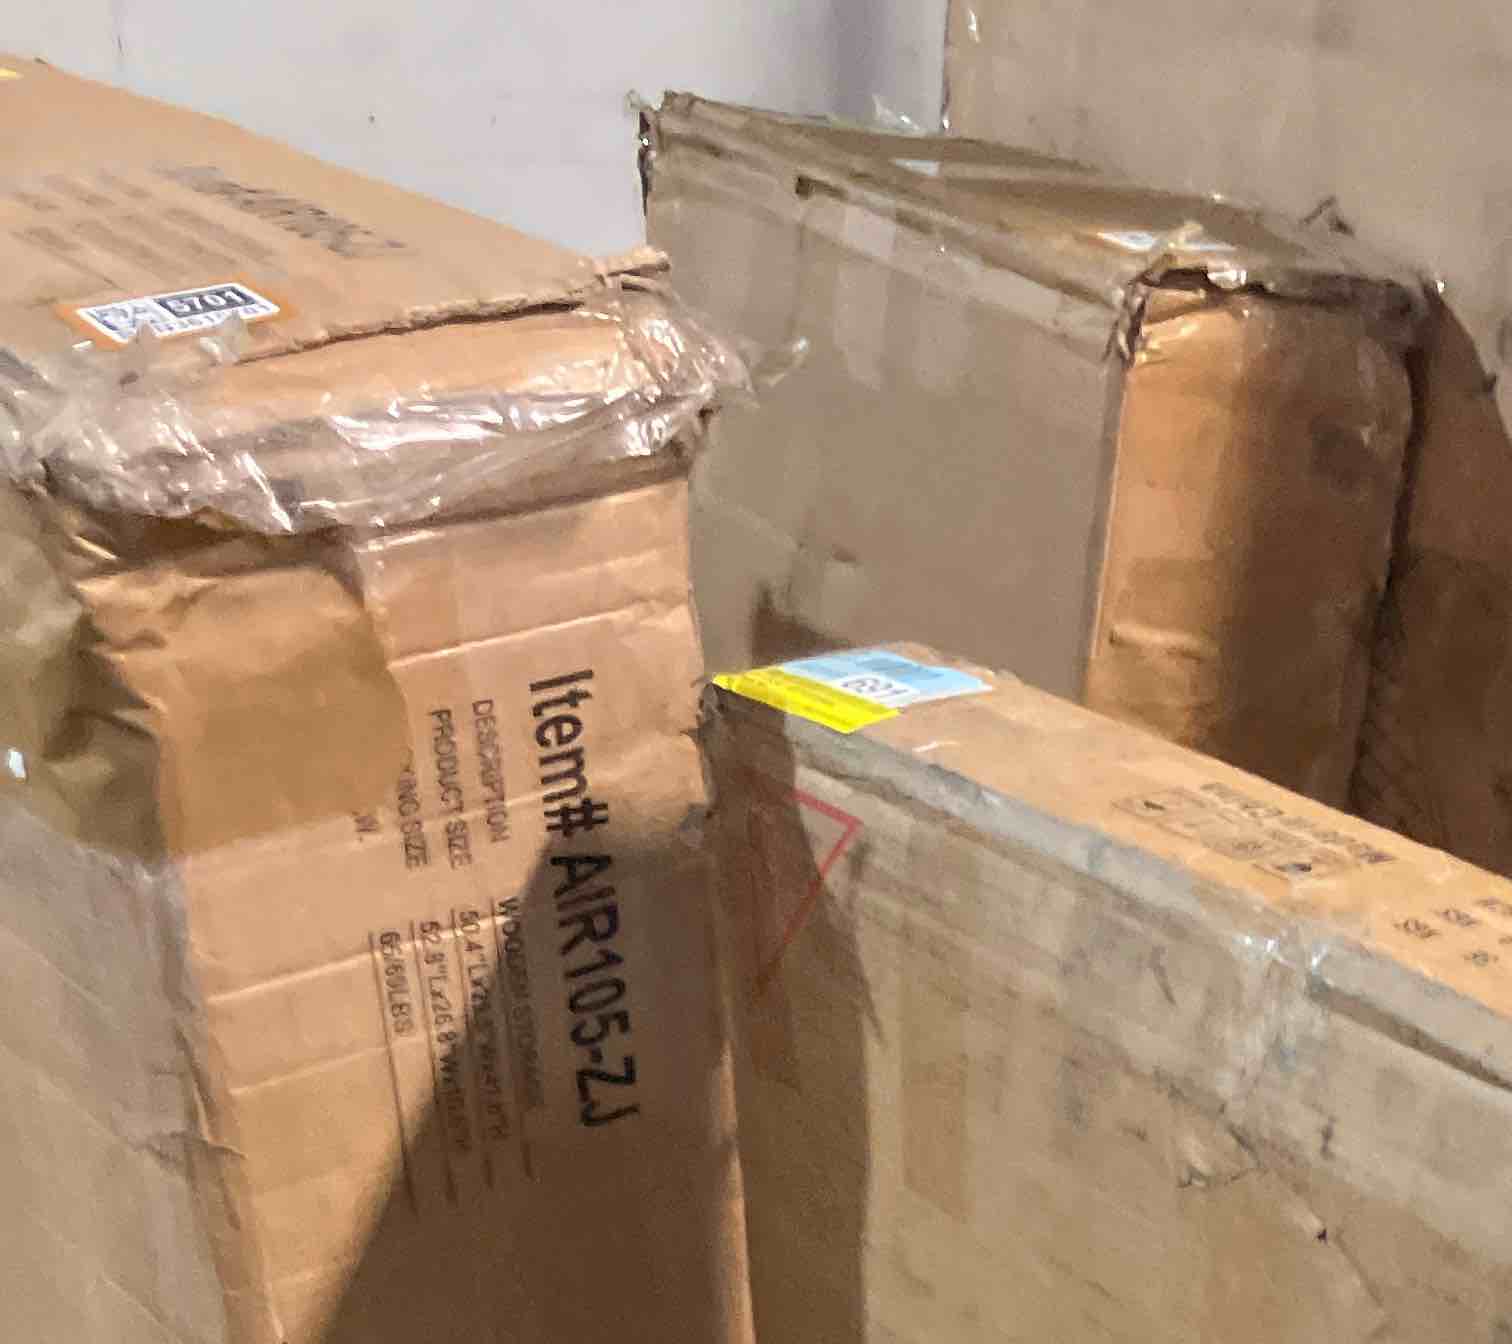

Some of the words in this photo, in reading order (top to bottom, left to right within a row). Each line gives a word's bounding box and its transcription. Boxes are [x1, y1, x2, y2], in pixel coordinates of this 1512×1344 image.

[429, 709, 464, 813] PRODUCT
[529, 669, 609, 838] Item#
[445, 817, 473, 871] SIZE
[550, 853, 640, 1128] AIR105-ZJ
